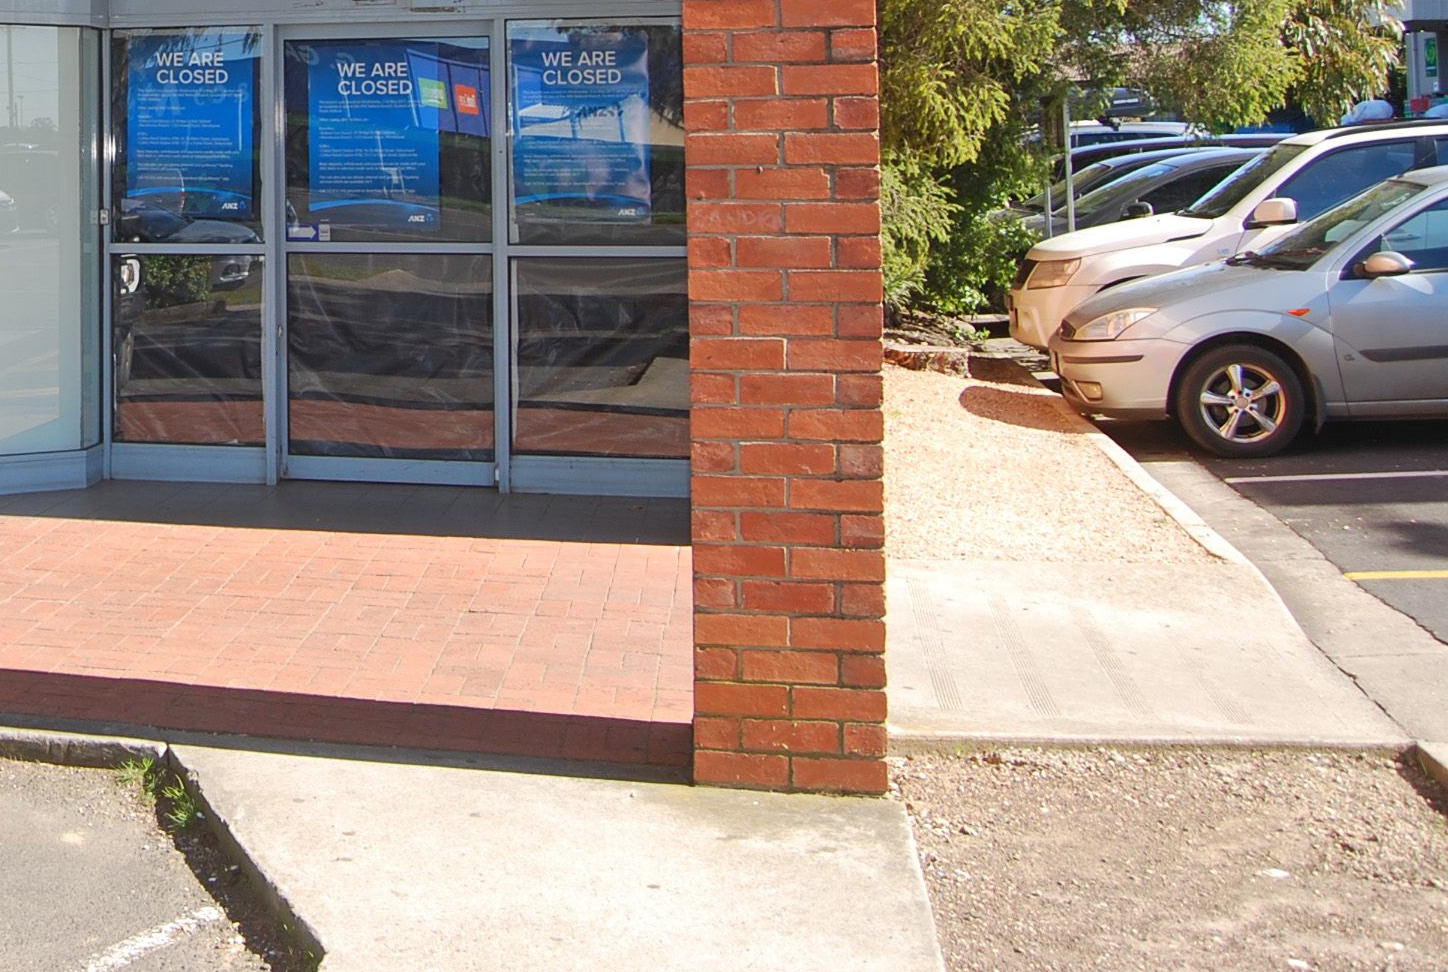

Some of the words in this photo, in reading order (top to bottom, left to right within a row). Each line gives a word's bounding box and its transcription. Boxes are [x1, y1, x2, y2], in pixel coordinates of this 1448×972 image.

[156, 52, 184, 67] WE
[188, 52, 224, 67] ARE
[541, 51, 572, 67] WE
[577, 50, 617, 66] ARE
[156, 69, 229, 84] CLOSED
[337, 62, 366, 77] WE
[370, 62, 408, 77] ARE
[542, 69, 622, 85] CLOSED
[337, 80, 413, 95] CLOSED
